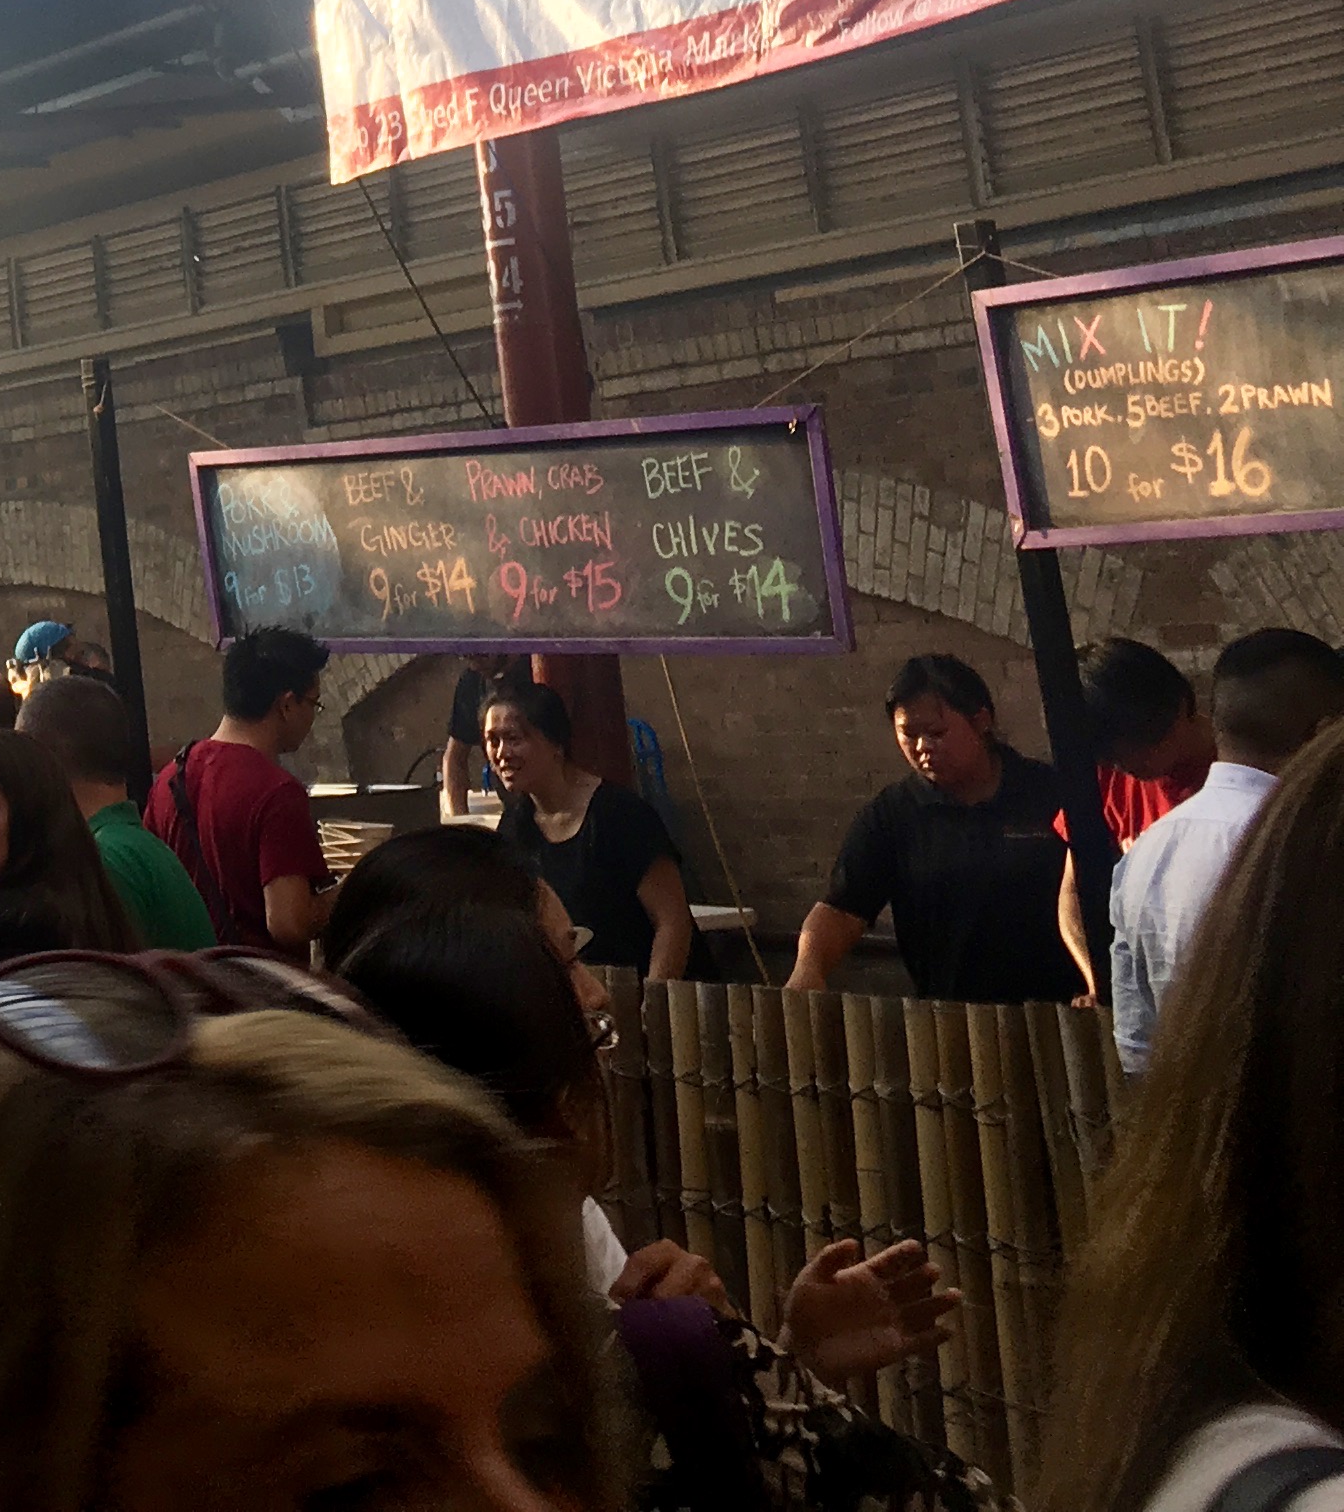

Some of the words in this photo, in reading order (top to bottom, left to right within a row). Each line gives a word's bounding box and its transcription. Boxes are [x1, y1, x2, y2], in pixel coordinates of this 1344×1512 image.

[374, 109, 403, 144] 23
[465, 87, 480, 125] F
[489, 73, 570, 117] Queen
[1020, 314, 1106, 372] MIX
[1137, 299, 1213, 354] IT!
[1064, 356, 1206, 394] (DUMPLINGS)
[344, 470, 397, 506] BEEF
[400, 467, 425, 506] &
[465, 459, 543, 501] PRAWN,
[547, 462, 604, 494] CRAB
[641, 452, 713, 499] BEEF
[728, 445, 761, 499] &
[1067, 445, 1112, 498] 10
[1128, 472, 1165, 502] for
[1170, 426, 1272, 498] $16
[217, 477, 276, 529] PORK
[278, 474, 300, 519] &
[221, 510, 339, 561] MUSHROOM
[361, 520, 458, 557] GINGER
[485, 513, 511, 559] &
[519, 511, 612, 550] CHICKEN
[652, 514, 764, 559] CHIVES
[224, 571, 242, 610] 9
[244, 584, 267, 607] for
[274, 563, 317, 606] $13
[368, 567, 390, 622] 9
[393, 583, 418, 616] for
[416, 557, 477, 615] $14
[500, 561, 527, 619] 9
[531, 575, 558, 609] for
[563, 559, 623, 613] $15
[665, 566, 694, 625] 9
[697, 579, 720, 614] for
[728, 556, 800, 623] $14
